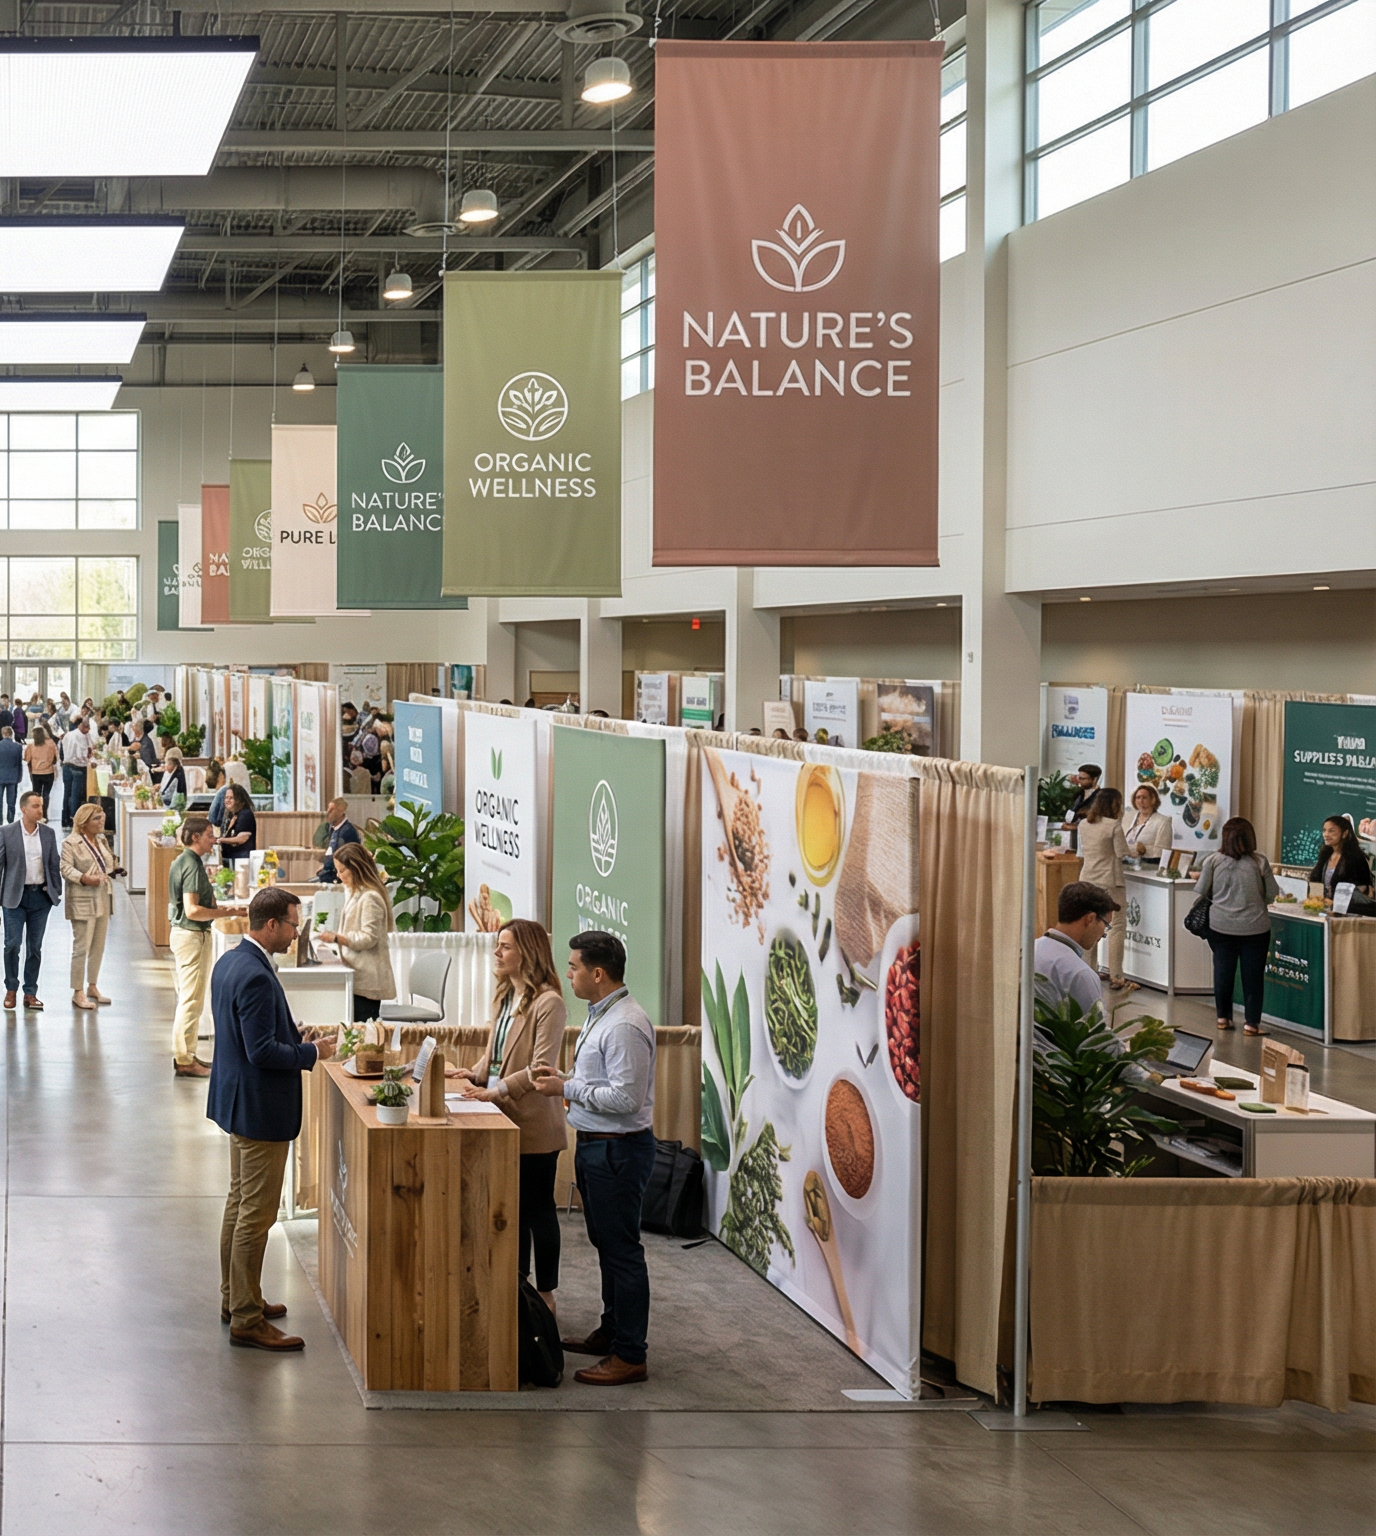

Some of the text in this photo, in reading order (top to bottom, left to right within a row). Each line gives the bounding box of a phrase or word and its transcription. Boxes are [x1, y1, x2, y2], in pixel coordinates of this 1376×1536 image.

[682, 311, 913, 349] NATURE'S
[685, 359, 912, 397] BALANCE
[474, 453, 592, 473] ORGANIC
[469, 478, 596, 498] WELLNESS
[351, 492, 444, 509] NATURE'
[352, 513, 442, 532] BALANC
[280, 530, 324, 544] PURE
[576, 883, 629, 927] ORGANIC
